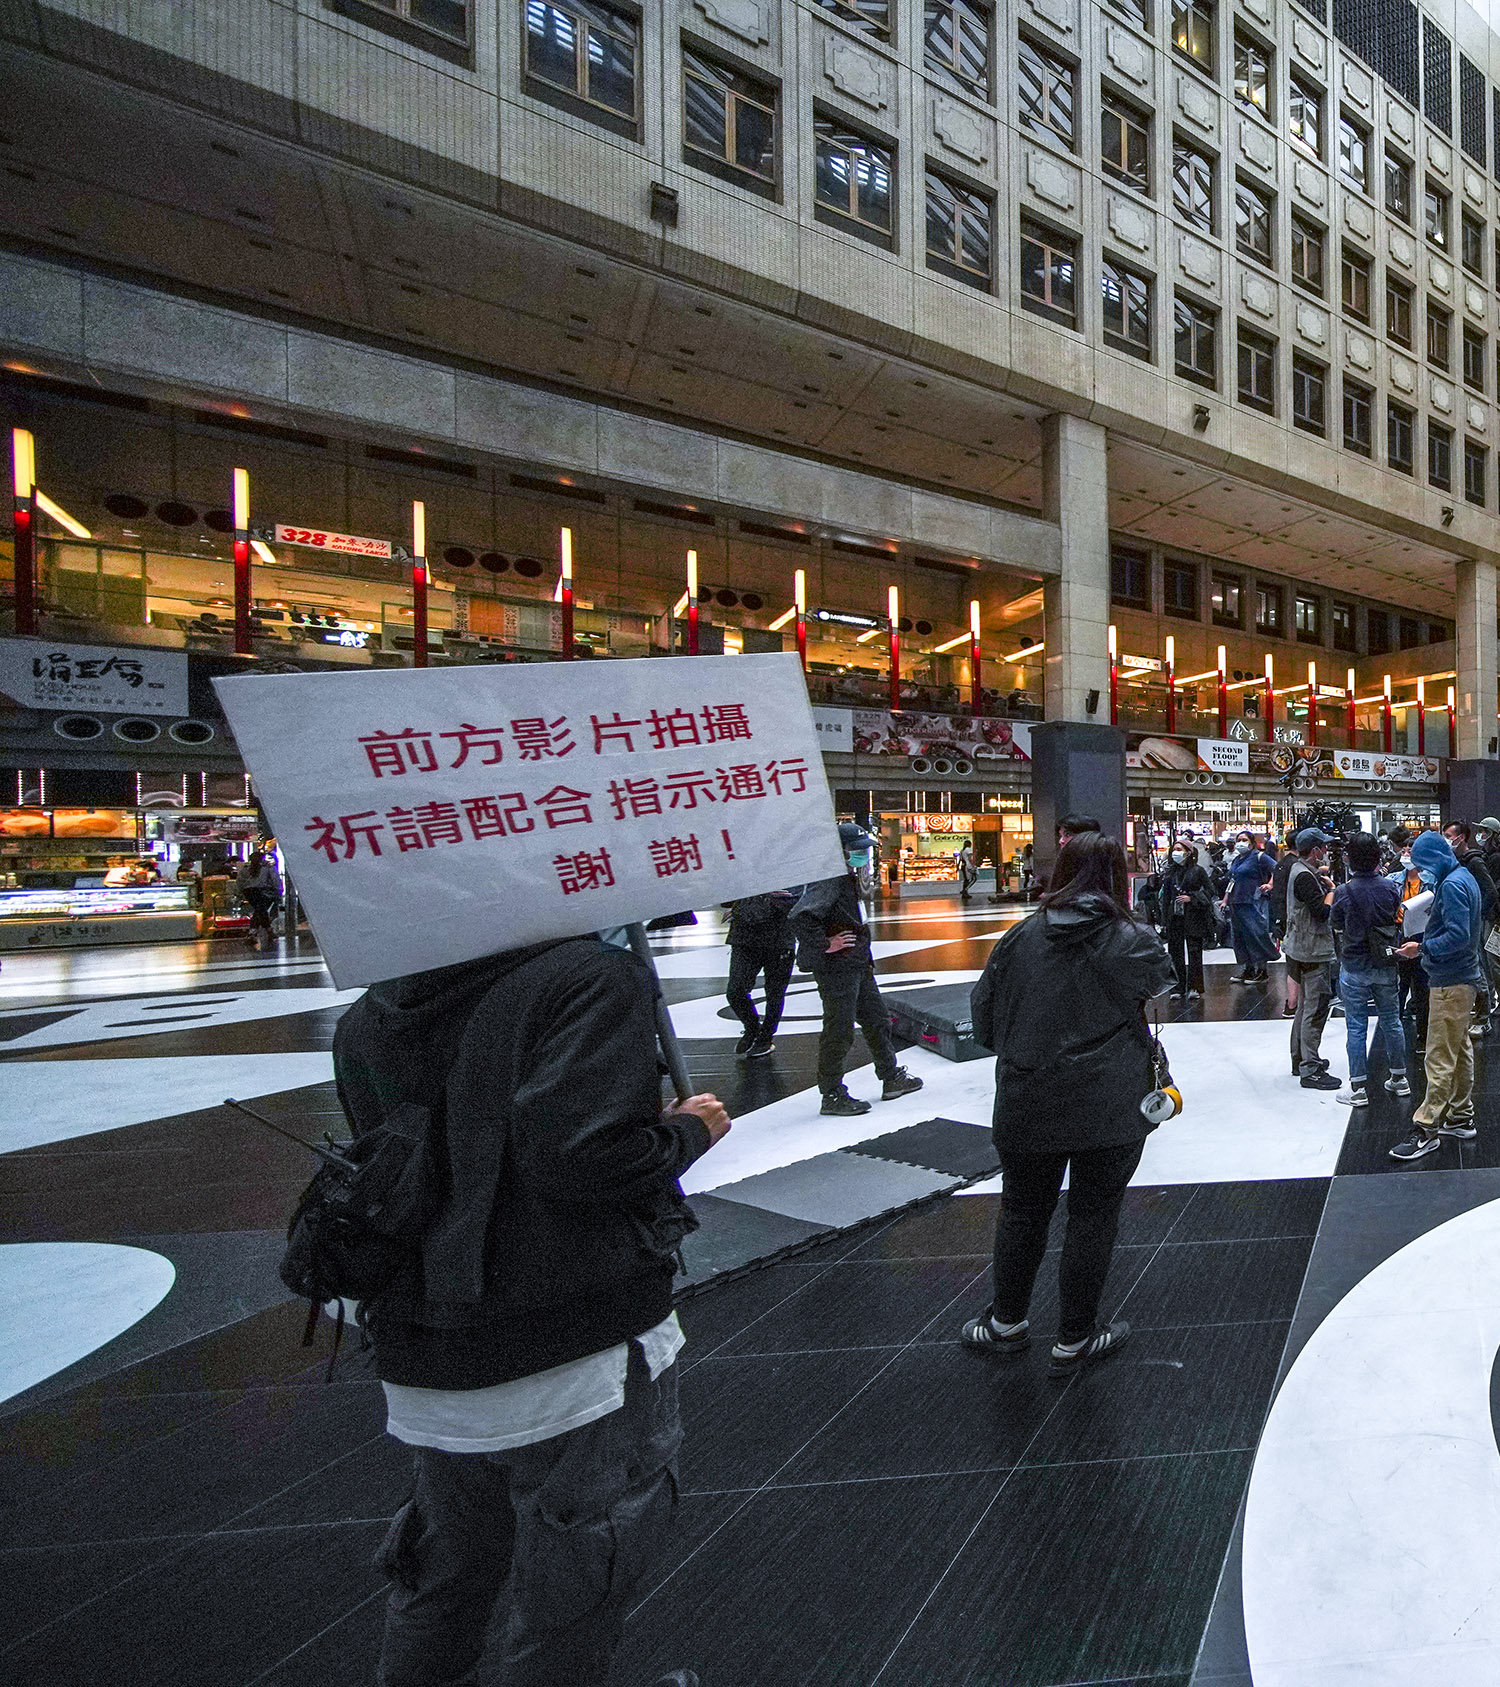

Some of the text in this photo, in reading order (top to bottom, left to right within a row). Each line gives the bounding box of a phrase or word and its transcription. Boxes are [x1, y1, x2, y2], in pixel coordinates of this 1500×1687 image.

[281, 528, 328, 547] 328
[358, 703, 754, 778] 前方影片拍攝
[1212, 745, 1243, 754] SECOND
[304, 758, 810, 863] 祈請配合指示通行
[989, 797, 1024, 808] Breeze
